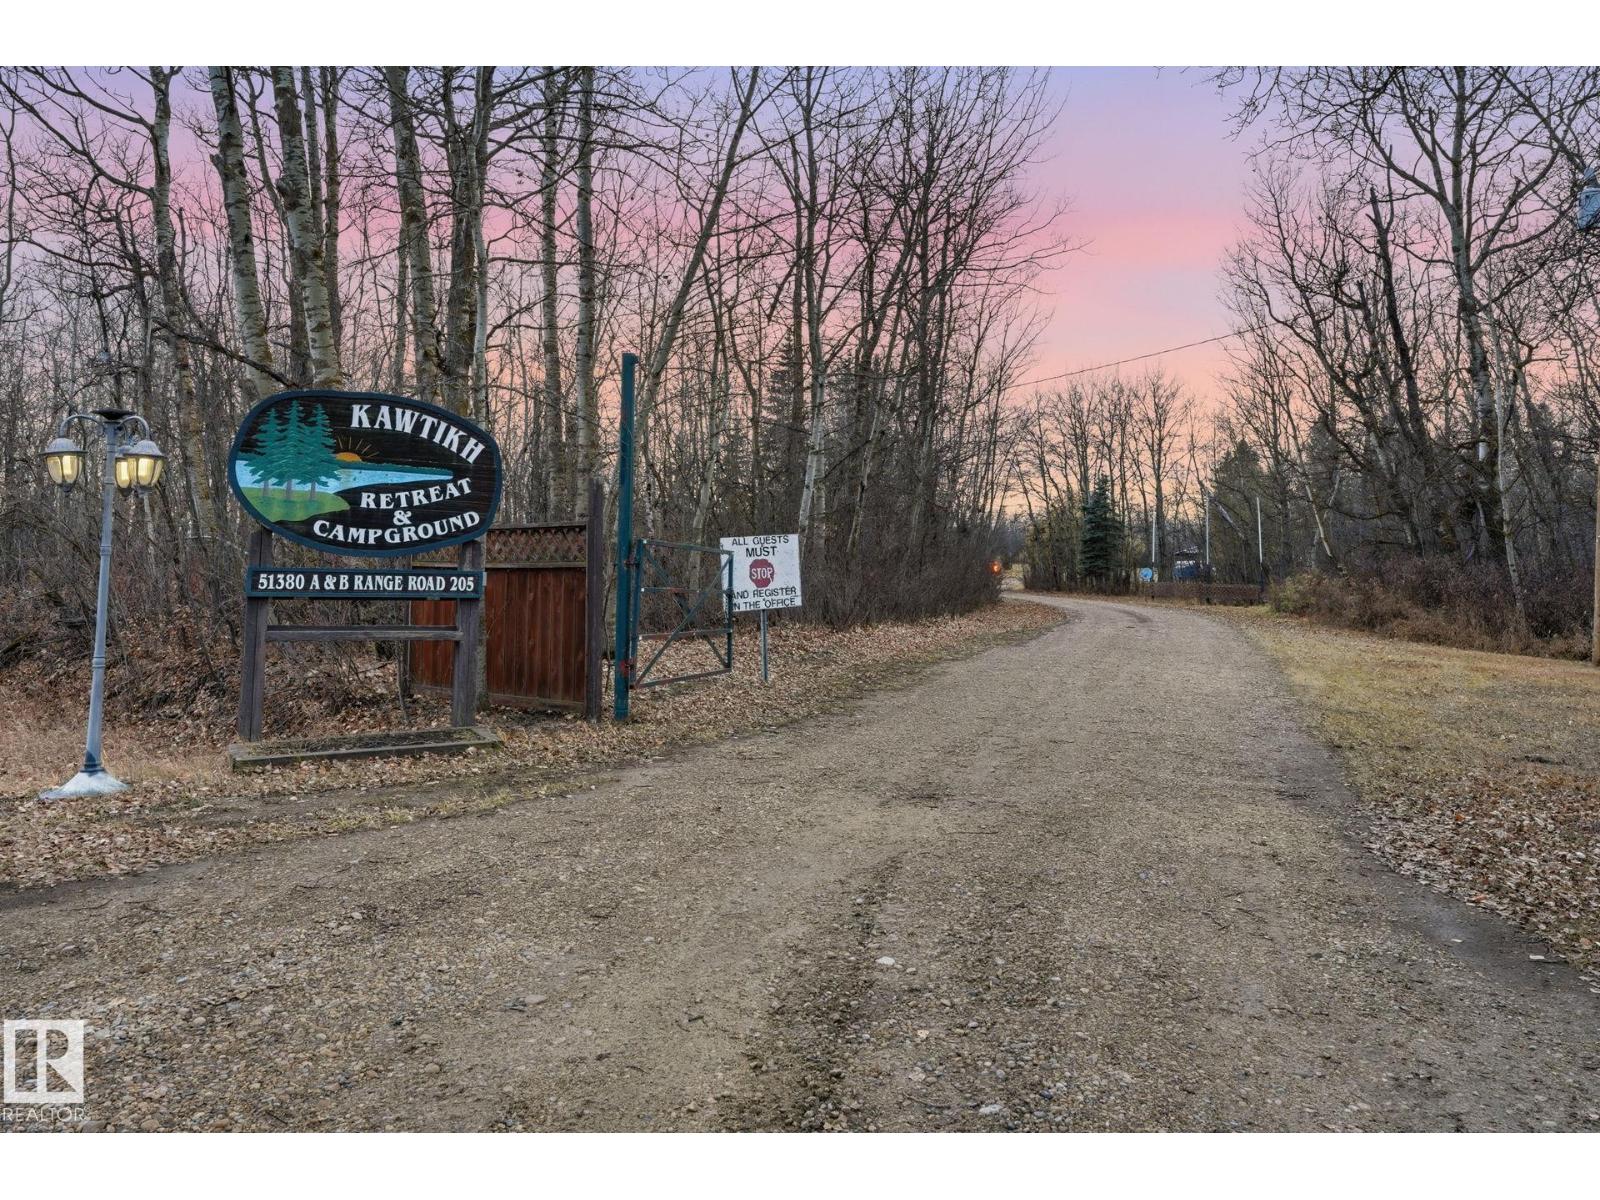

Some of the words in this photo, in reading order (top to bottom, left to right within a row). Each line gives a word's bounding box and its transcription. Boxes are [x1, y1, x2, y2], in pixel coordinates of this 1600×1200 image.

[351, 404, 485, 464] KAWTIKH
[359, 477, 472, 509] RETREAT
[393, 510, 412, 526] &
[313, 511, 480, 545] CAMPGROUND
[731, 538, 749, 546] ALL
[752, 535, 789, 545] GUESTS
[745, 546, 777, 557] MUST
[751, 567, 773, 580] STOP
[258, 573, 305, 590] 51380
[353, 575, 403, 591] RANGE
[407, 576, 446, 591] ROAD
[449, 576, 475, 591] 205
[752, 586, 797, 598] REGISTER
[743, 601, 761, 610] THE
[764, 598, 796, 608] OFFICE
